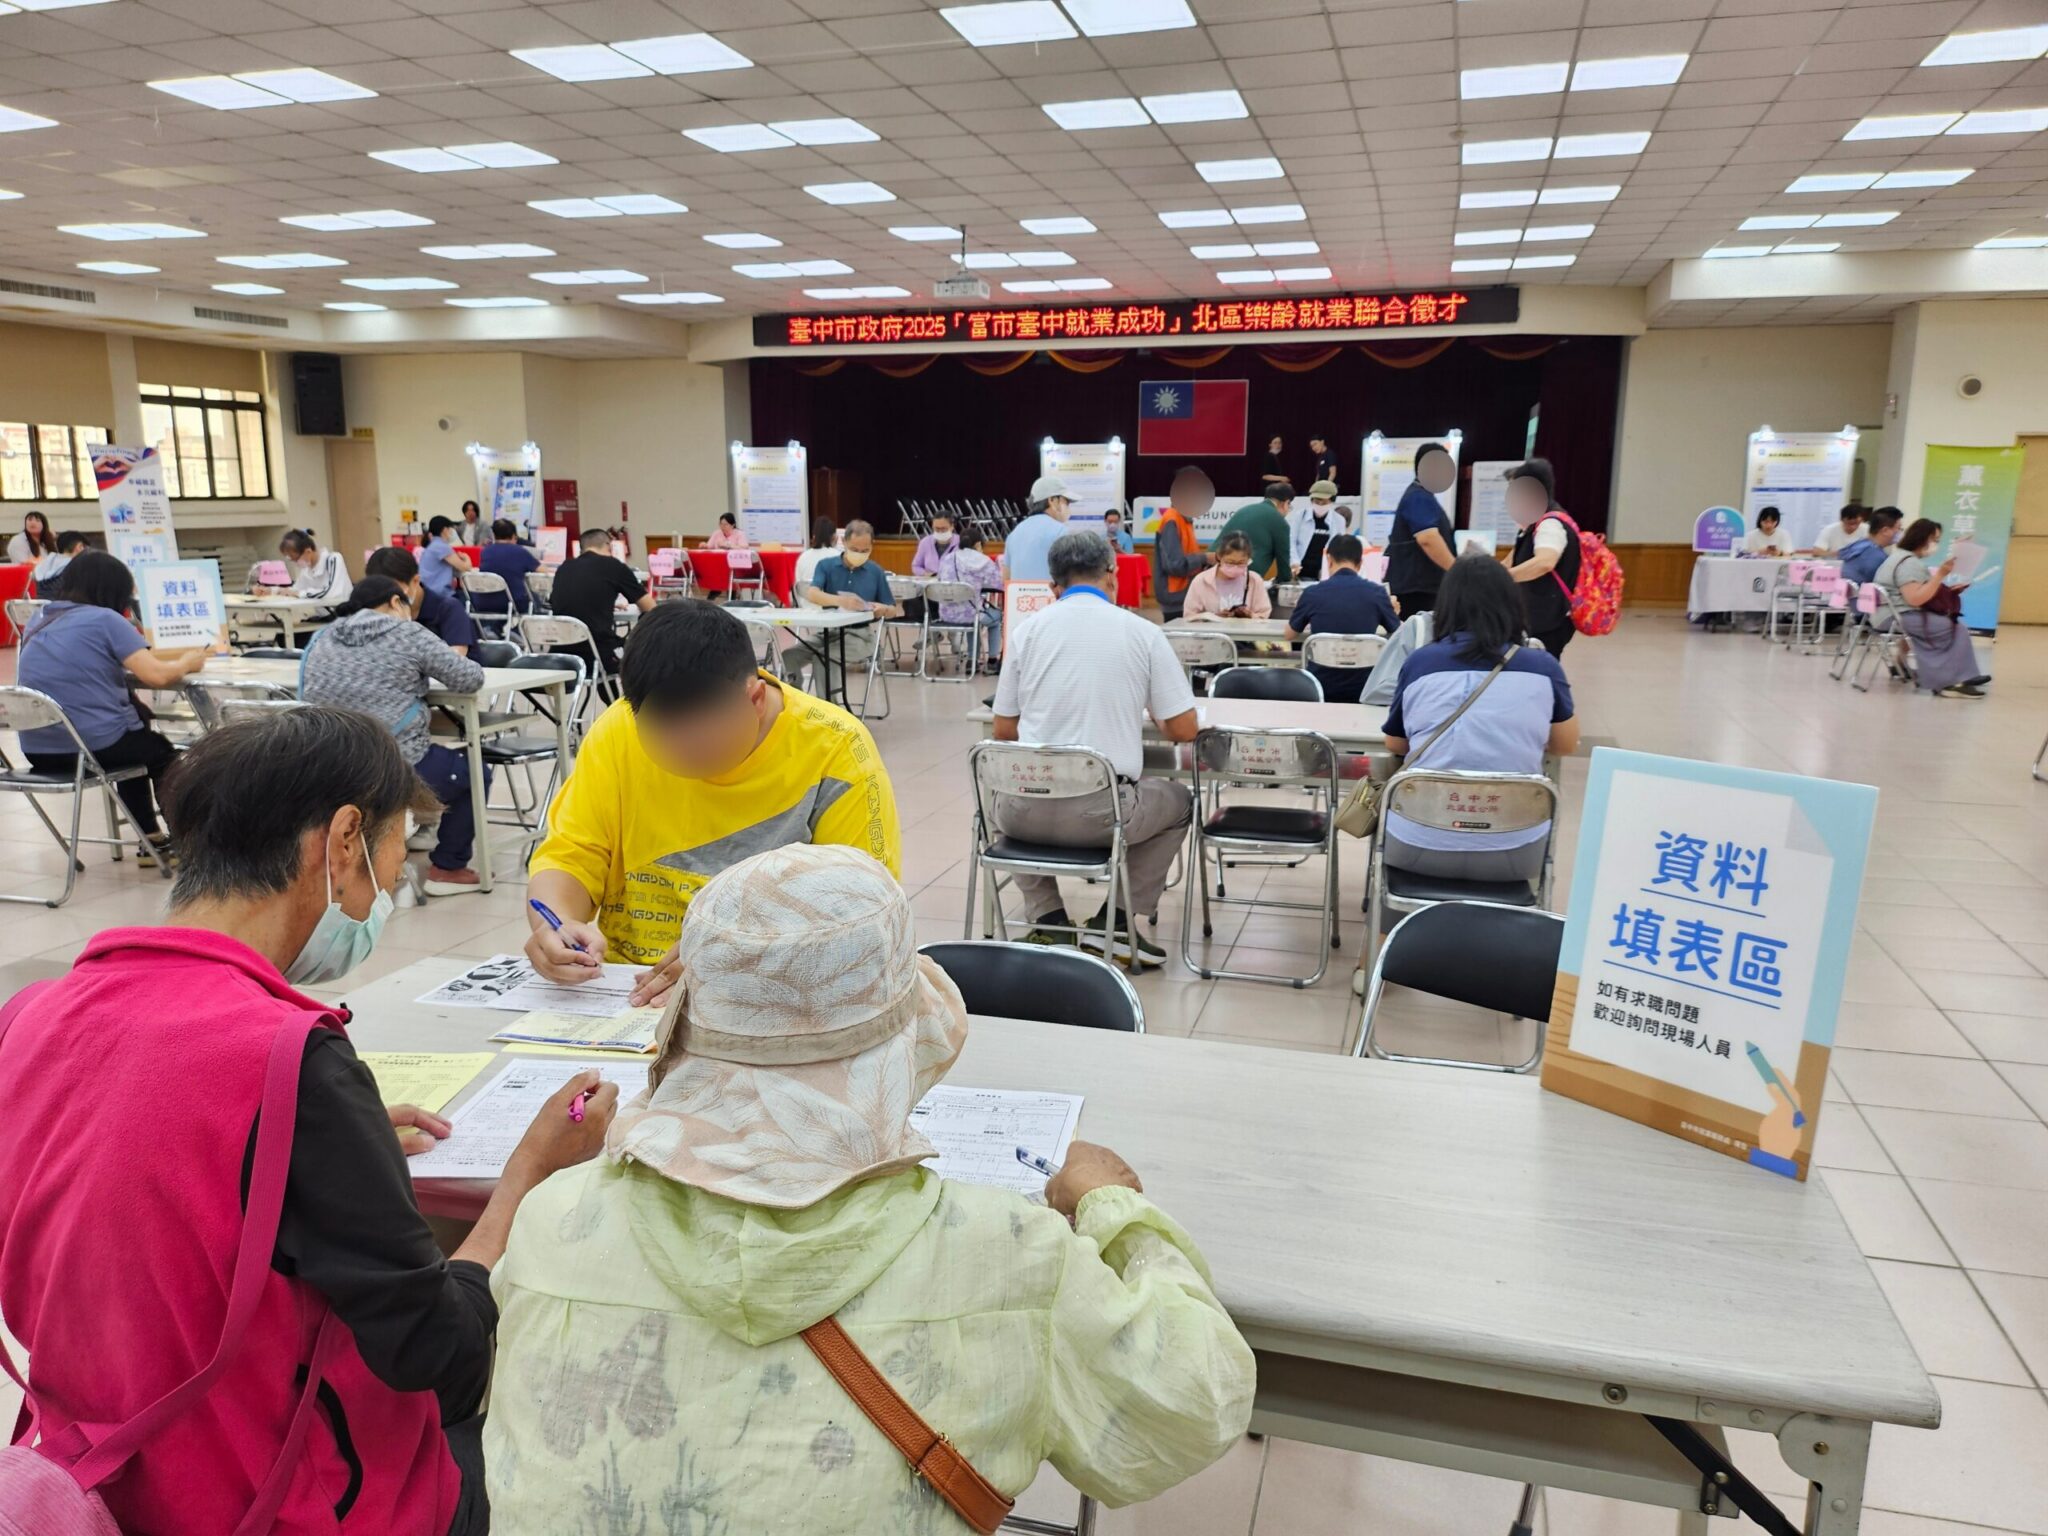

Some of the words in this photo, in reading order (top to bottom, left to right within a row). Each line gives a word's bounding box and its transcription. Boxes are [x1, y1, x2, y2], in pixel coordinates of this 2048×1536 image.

[157, 601, 211, 619] 填表區
[162, 579, 197, 597] 資料
[1650, 829, 1770, 907] 資料
[1608, 902, 1789, 999] 填表區
[1596, 979, 1701, 1025] 如有求職問題
[1593, 1002, 1732, 1060] 歡迎詢問現場人員
